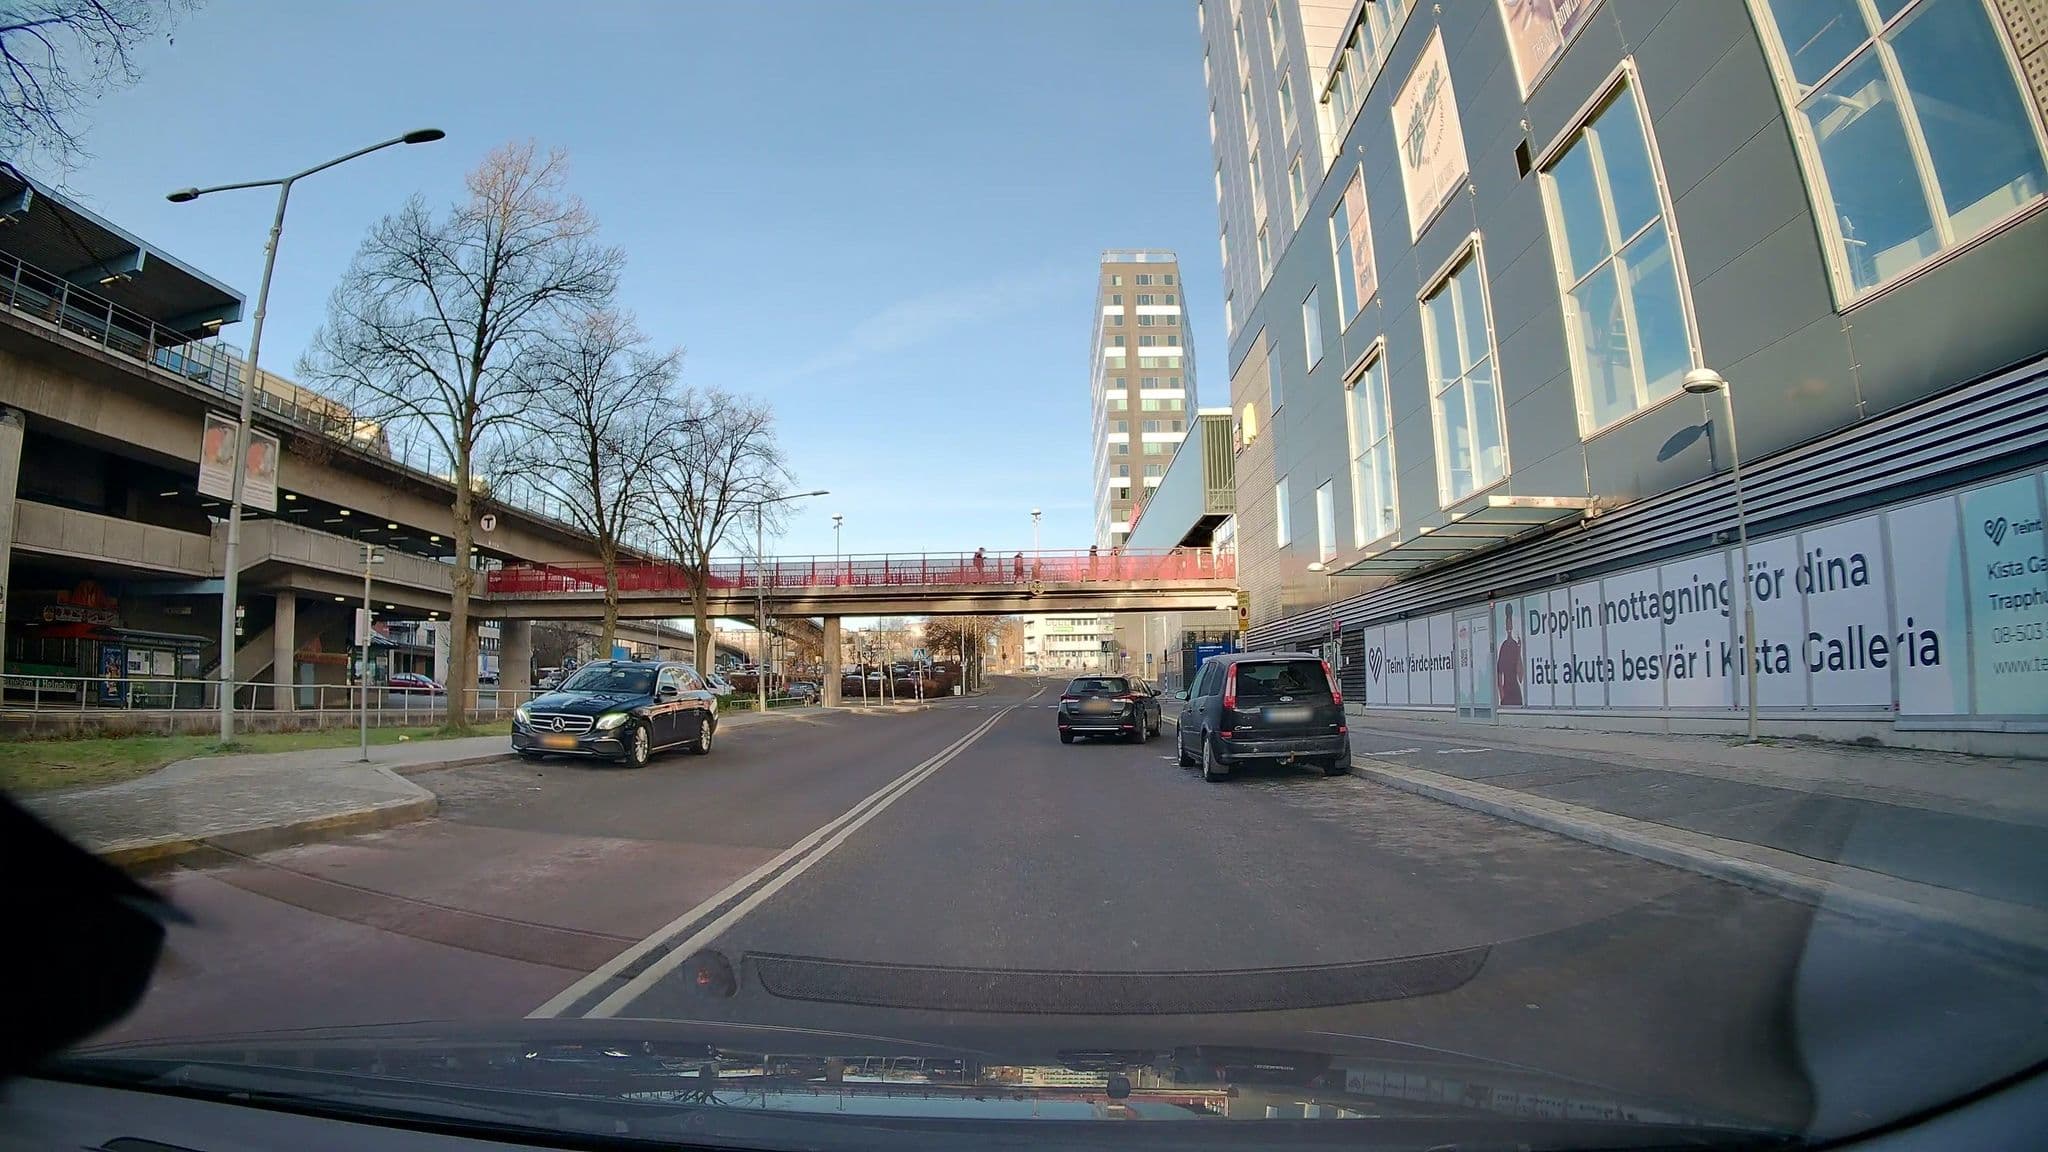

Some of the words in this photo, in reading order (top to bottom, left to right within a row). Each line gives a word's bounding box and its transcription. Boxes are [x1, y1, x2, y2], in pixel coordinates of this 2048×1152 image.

[484, 517, 494, 529] T
[2011, 519, 2043, 537] Teint
[1987, 560, 2024, 580] Kista
[1529, 598, 1593, 639] Drop-in
[1599, 574, 1731, 626] mottagning
[1795, 548, 1870, 594] dina
[1993, 622, 2042, 645] 08-503
[1386, 656, 1405, 674] Teint
[1531, 655, 1558, 685] lätt
[1563, 653, 1615, 685] akuta
[1622, 644, 1697, 681] besvär
[1705, 639, 1712, 678] i
